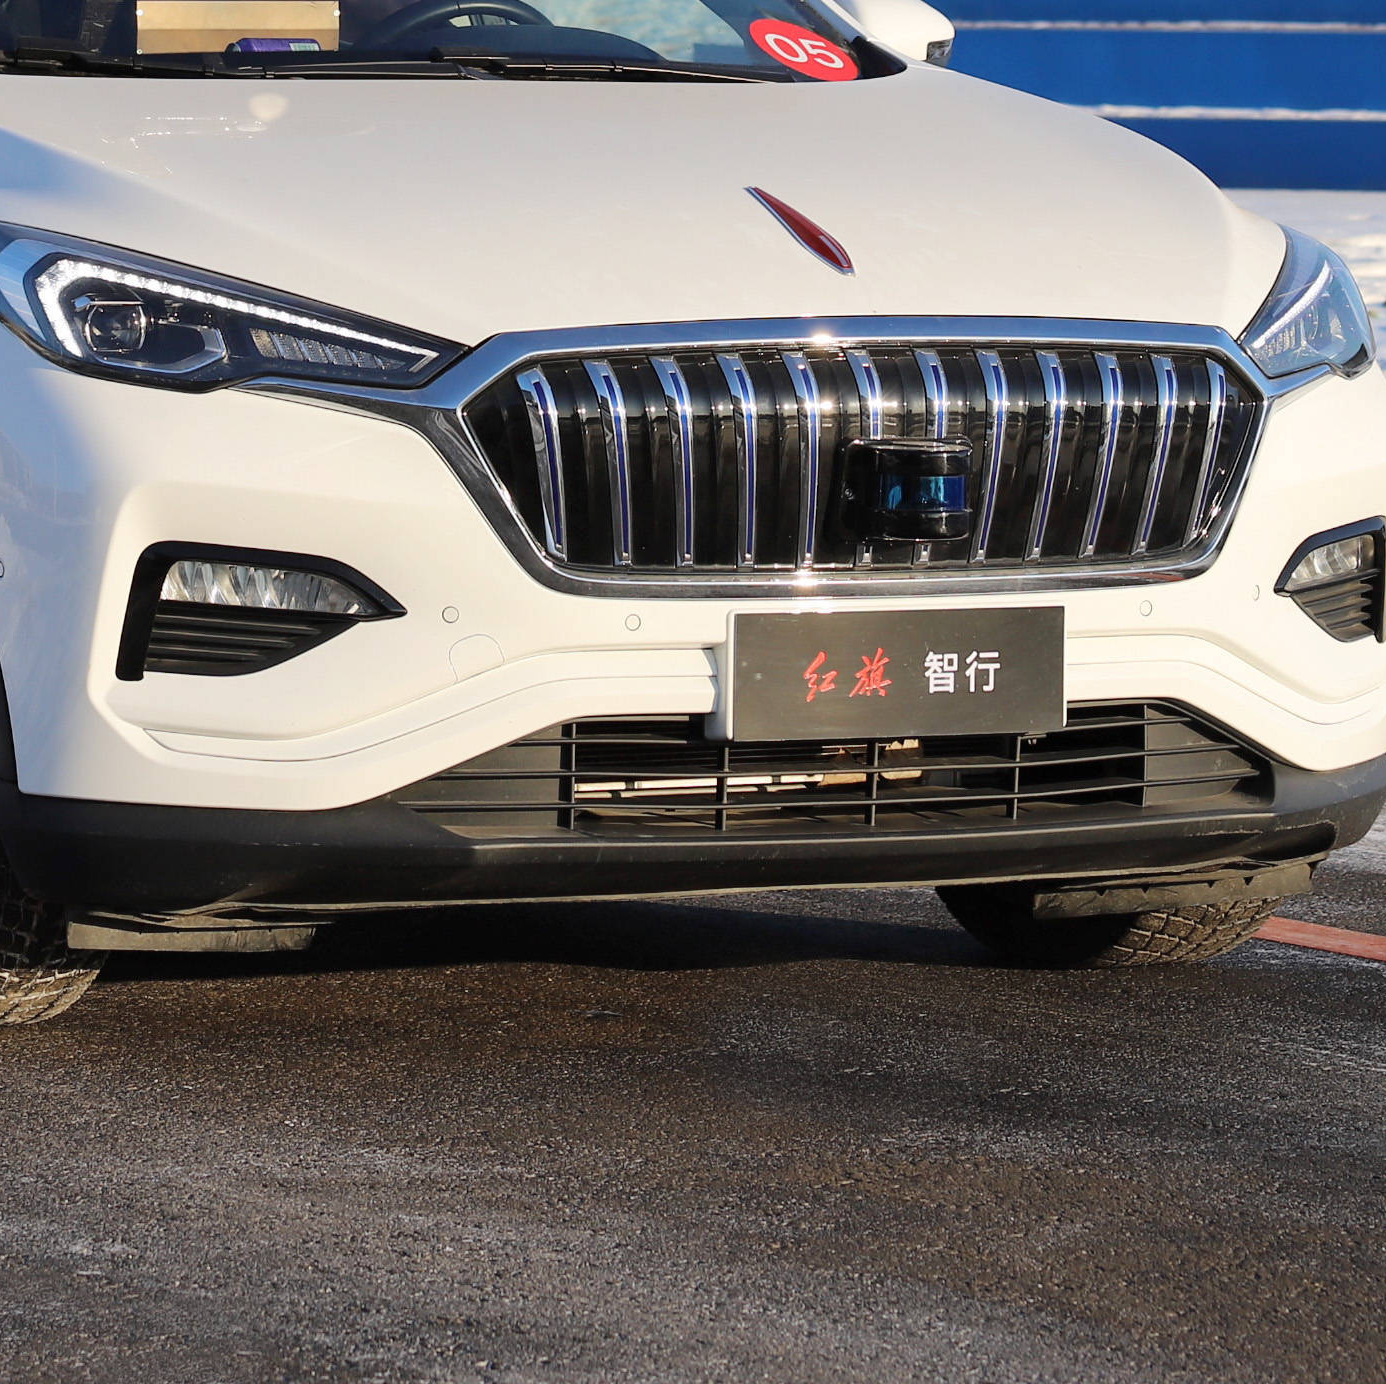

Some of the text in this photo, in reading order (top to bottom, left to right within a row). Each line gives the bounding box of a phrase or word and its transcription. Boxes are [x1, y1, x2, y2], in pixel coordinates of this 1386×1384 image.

[764, 33, 845, 69] 05
[803, 647, 1002, 703] 红旗 智行
